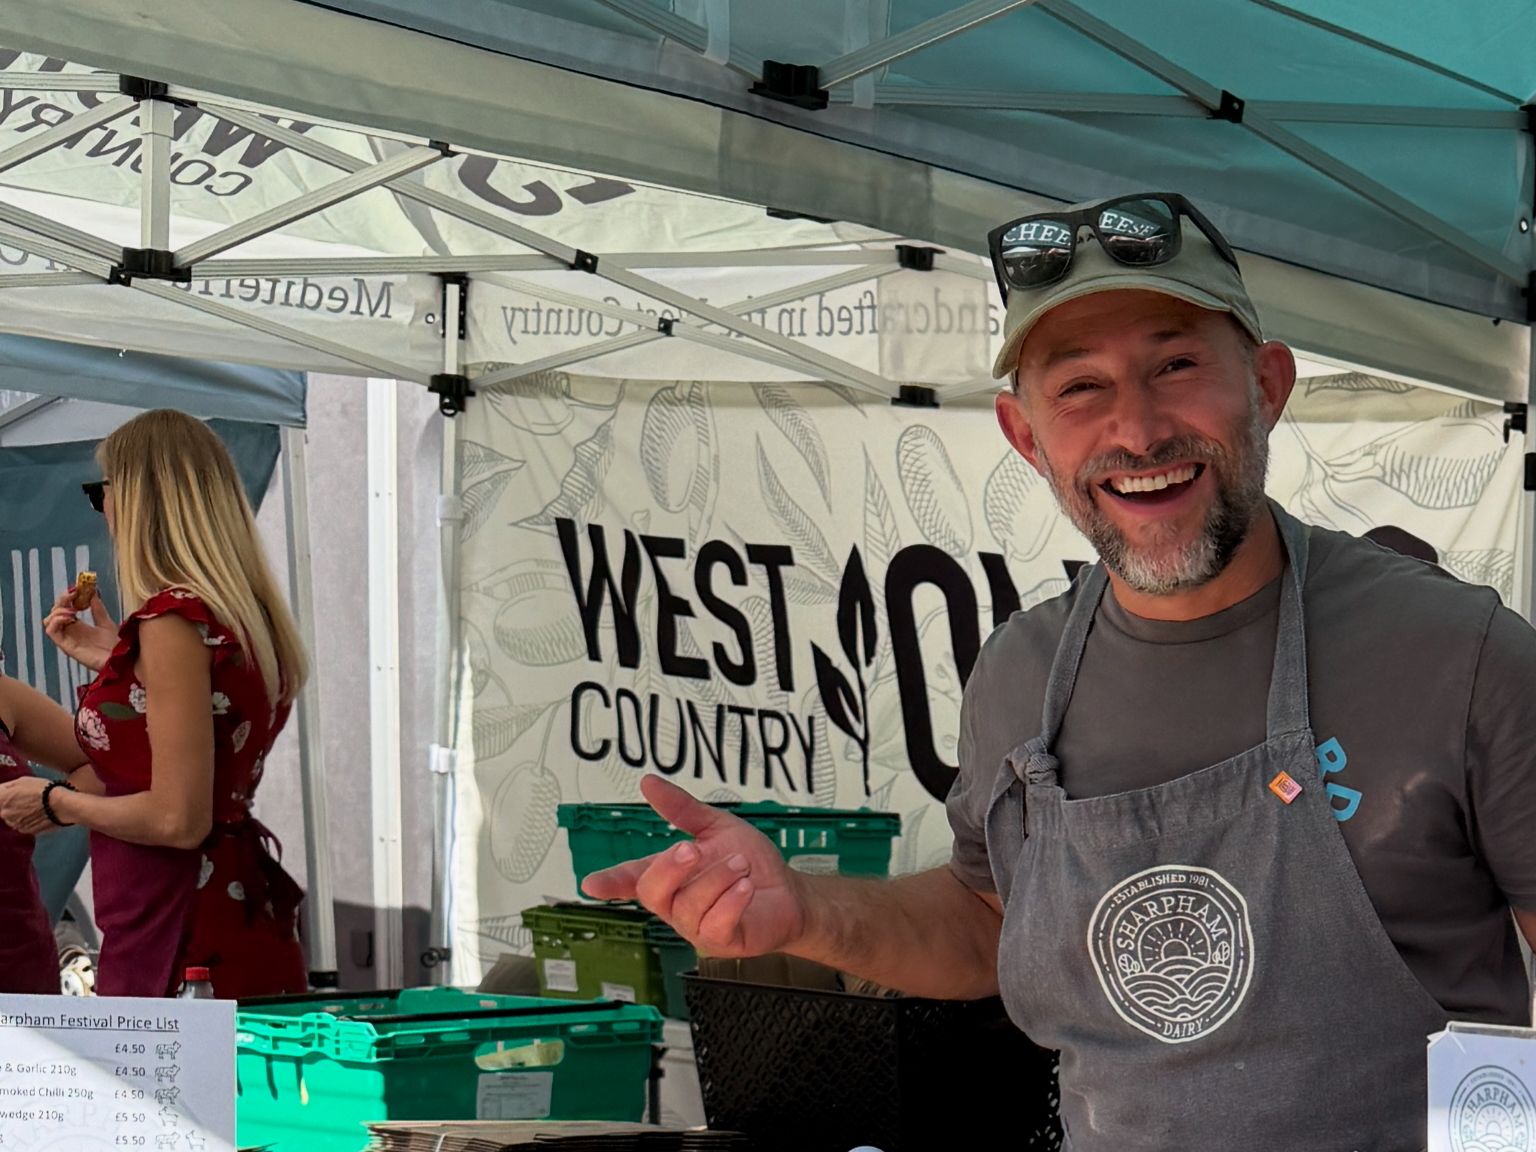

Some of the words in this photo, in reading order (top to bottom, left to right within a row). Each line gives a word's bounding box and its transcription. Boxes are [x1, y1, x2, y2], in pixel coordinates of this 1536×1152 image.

[555, 516, 795, 691] WEST
[570, 680, 815, 795] COUNTRY
[1113, 874, 1187, 905] ESTABLISHED
[1188, 874, 1210, 888] 1981
[1116, 895, 1227, 951] SHARPHAM
[60, 1013, 112, 1028] Festival
[117, 1016, 152, 1030] Price
[156, 1017, 179, 1030] List
[1164, 1018, 1204, 1038] DAIRY
[115, 1043, 146, 1054] £4.50
[17, 1064, 48, 1074] Garlic
[51, 1064, 77, 1076] 210g
[115, 1066, 146, 1077] £4.50
[38, 1087, 65, 1097] Chilli
[68, 1088, 94, 1100] 250g
[38, 1110, 64, 1122] 210g
[115, 1136, 146, 1146] £5.50
